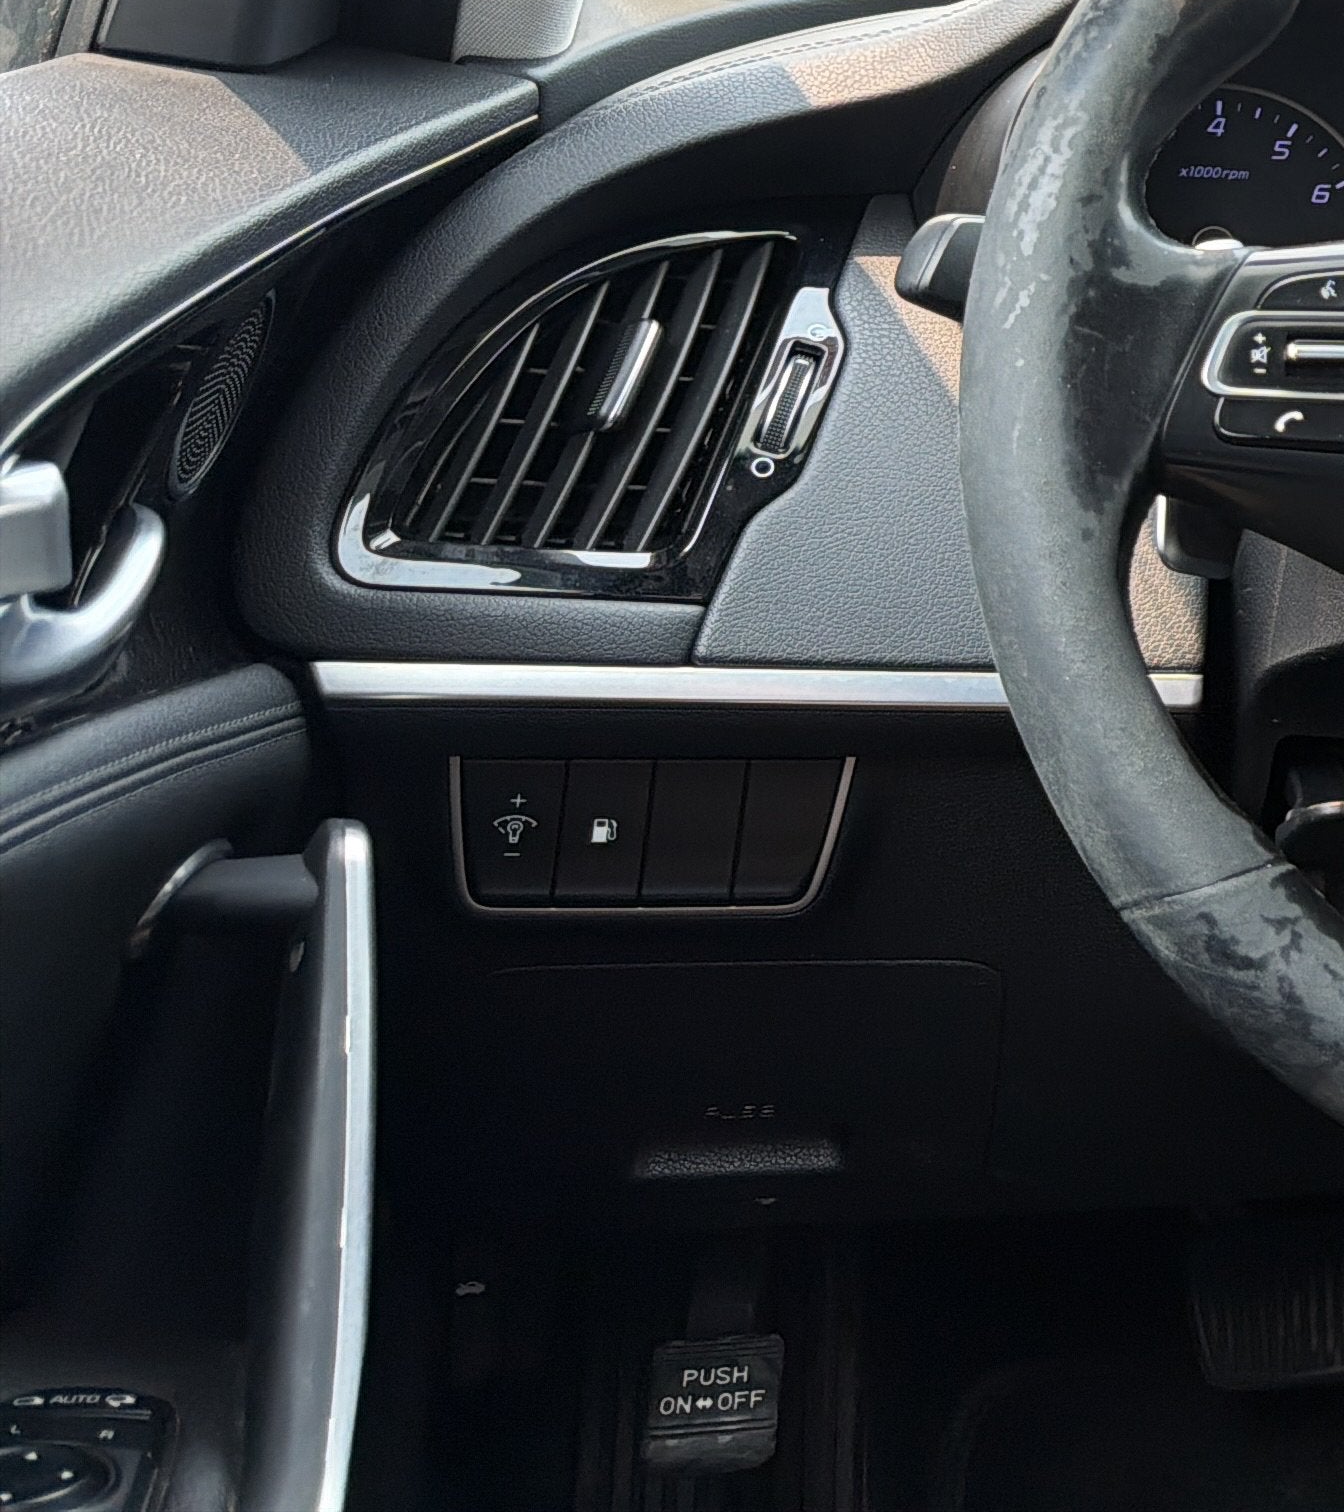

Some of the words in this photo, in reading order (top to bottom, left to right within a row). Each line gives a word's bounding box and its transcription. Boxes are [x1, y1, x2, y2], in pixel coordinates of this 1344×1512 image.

[1206, 117, 1227, 137] 4
[1271, 140, 1292, 160] 5
[1311, 184, 1332, 204] 6
[682, 1365, 749, 1388] PUSH
[50, 1394, 101, 1405] AUTO
[660, 1395, 692, 1416] ON
[717, 1389, 766, 1411] OFF
